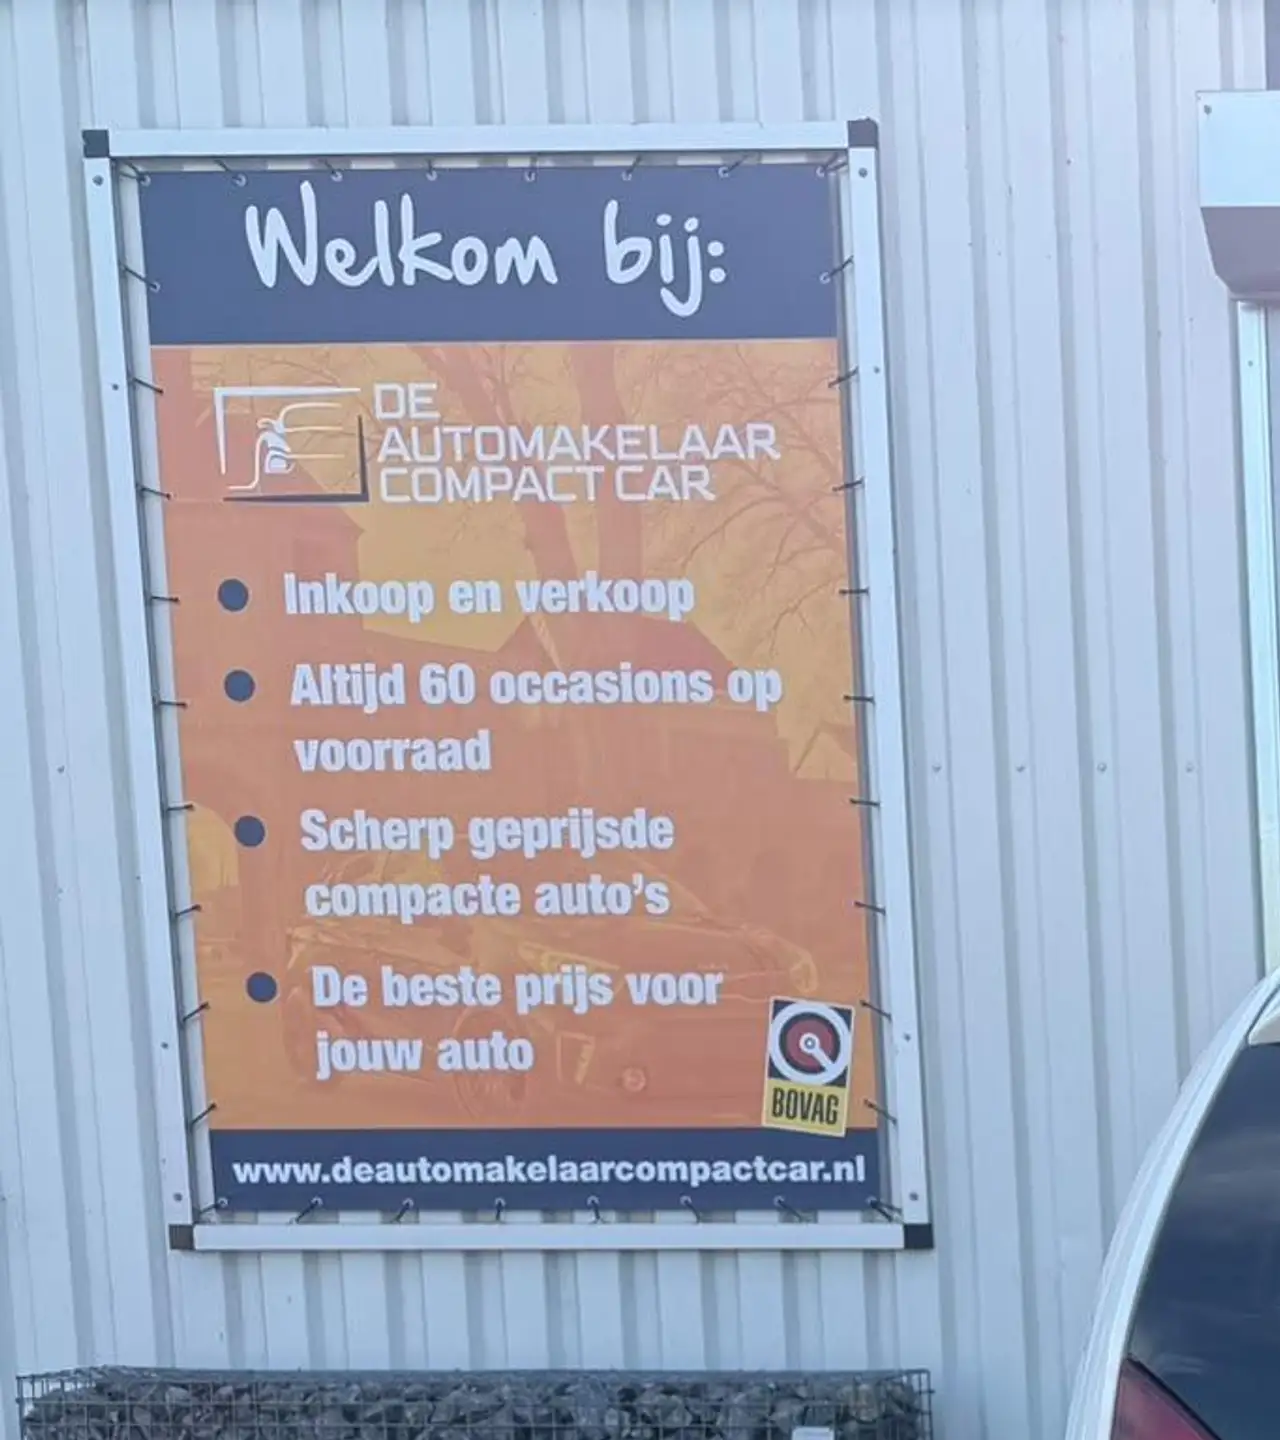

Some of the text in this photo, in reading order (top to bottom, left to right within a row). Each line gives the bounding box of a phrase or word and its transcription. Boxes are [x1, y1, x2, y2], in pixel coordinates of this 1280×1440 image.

[245, 180, 728, 317] Welkom bij:
[374, 382, 439, 421] DE
[378, 423, 781, 463] AUTOMAKELAAR
[379, 462, 717, 504] COMPACT CAR
[283, 570, 696, 622] Inkoop en verkoop
[290, 660, 783, 714] Altijd 60 occasions op
[293, 728, 492, 772] voorraad
[300, 807, 675, 861] Scherp geprijsde
[304, 872, 671, 924] compacte auto's
[311, 963, 724, 1014] De beste prijs voor
[314, 1031, 534, 1081] jouw auto
[771, 1086, 840, 1126] BOVAG
[232, 1154, 866, 1188] www.deautomakelaarcompactcar.nl
